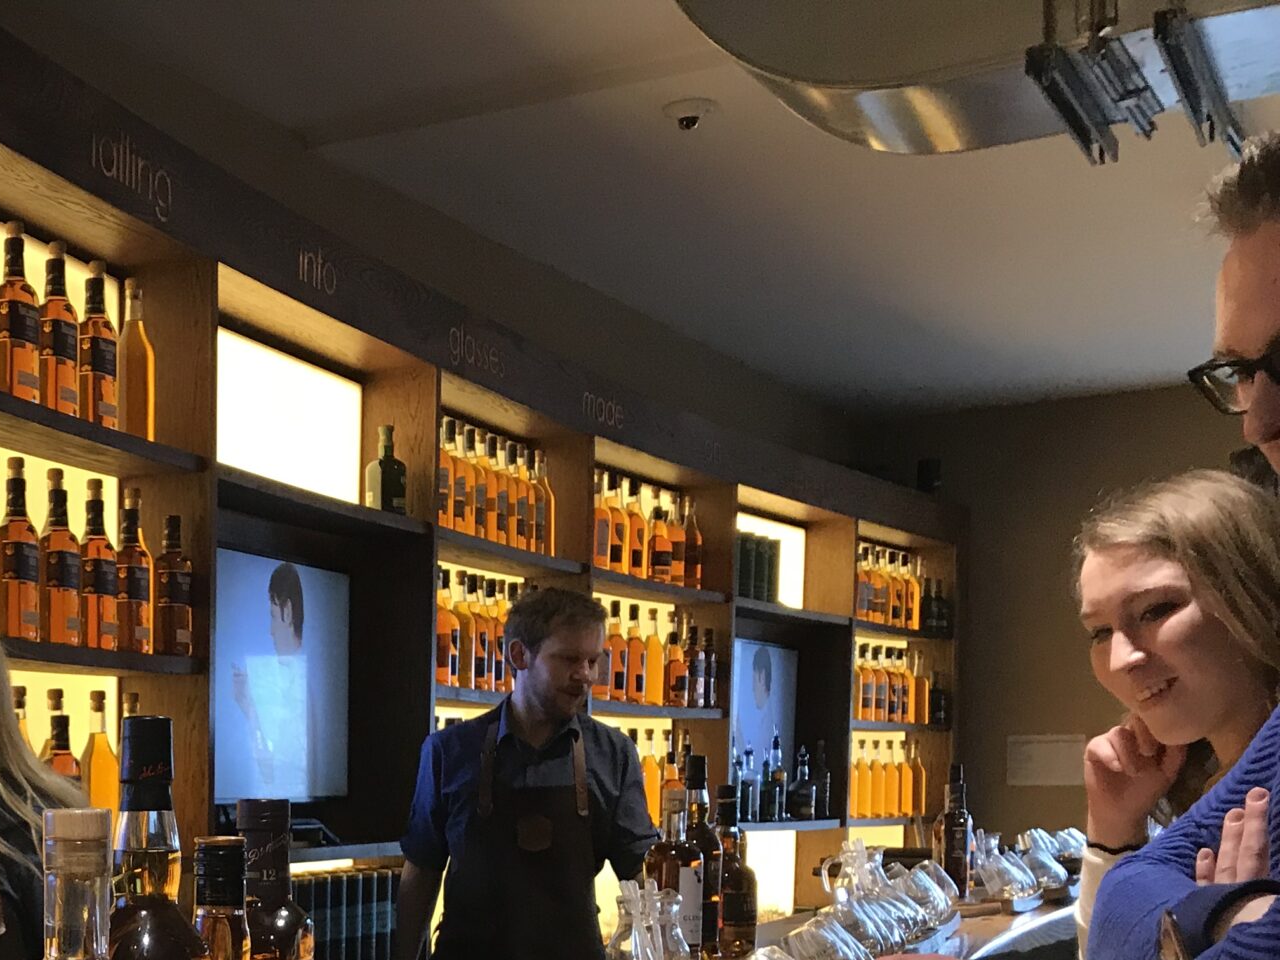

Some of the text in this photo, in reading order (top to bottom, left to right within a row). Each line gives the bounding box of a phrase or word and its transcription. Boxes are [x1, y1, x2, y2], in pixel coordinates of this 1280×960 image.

[448, 323, 506, 379] glasses
[582, 390, 625, 430] made
[261, 868, 277, 881] 12
